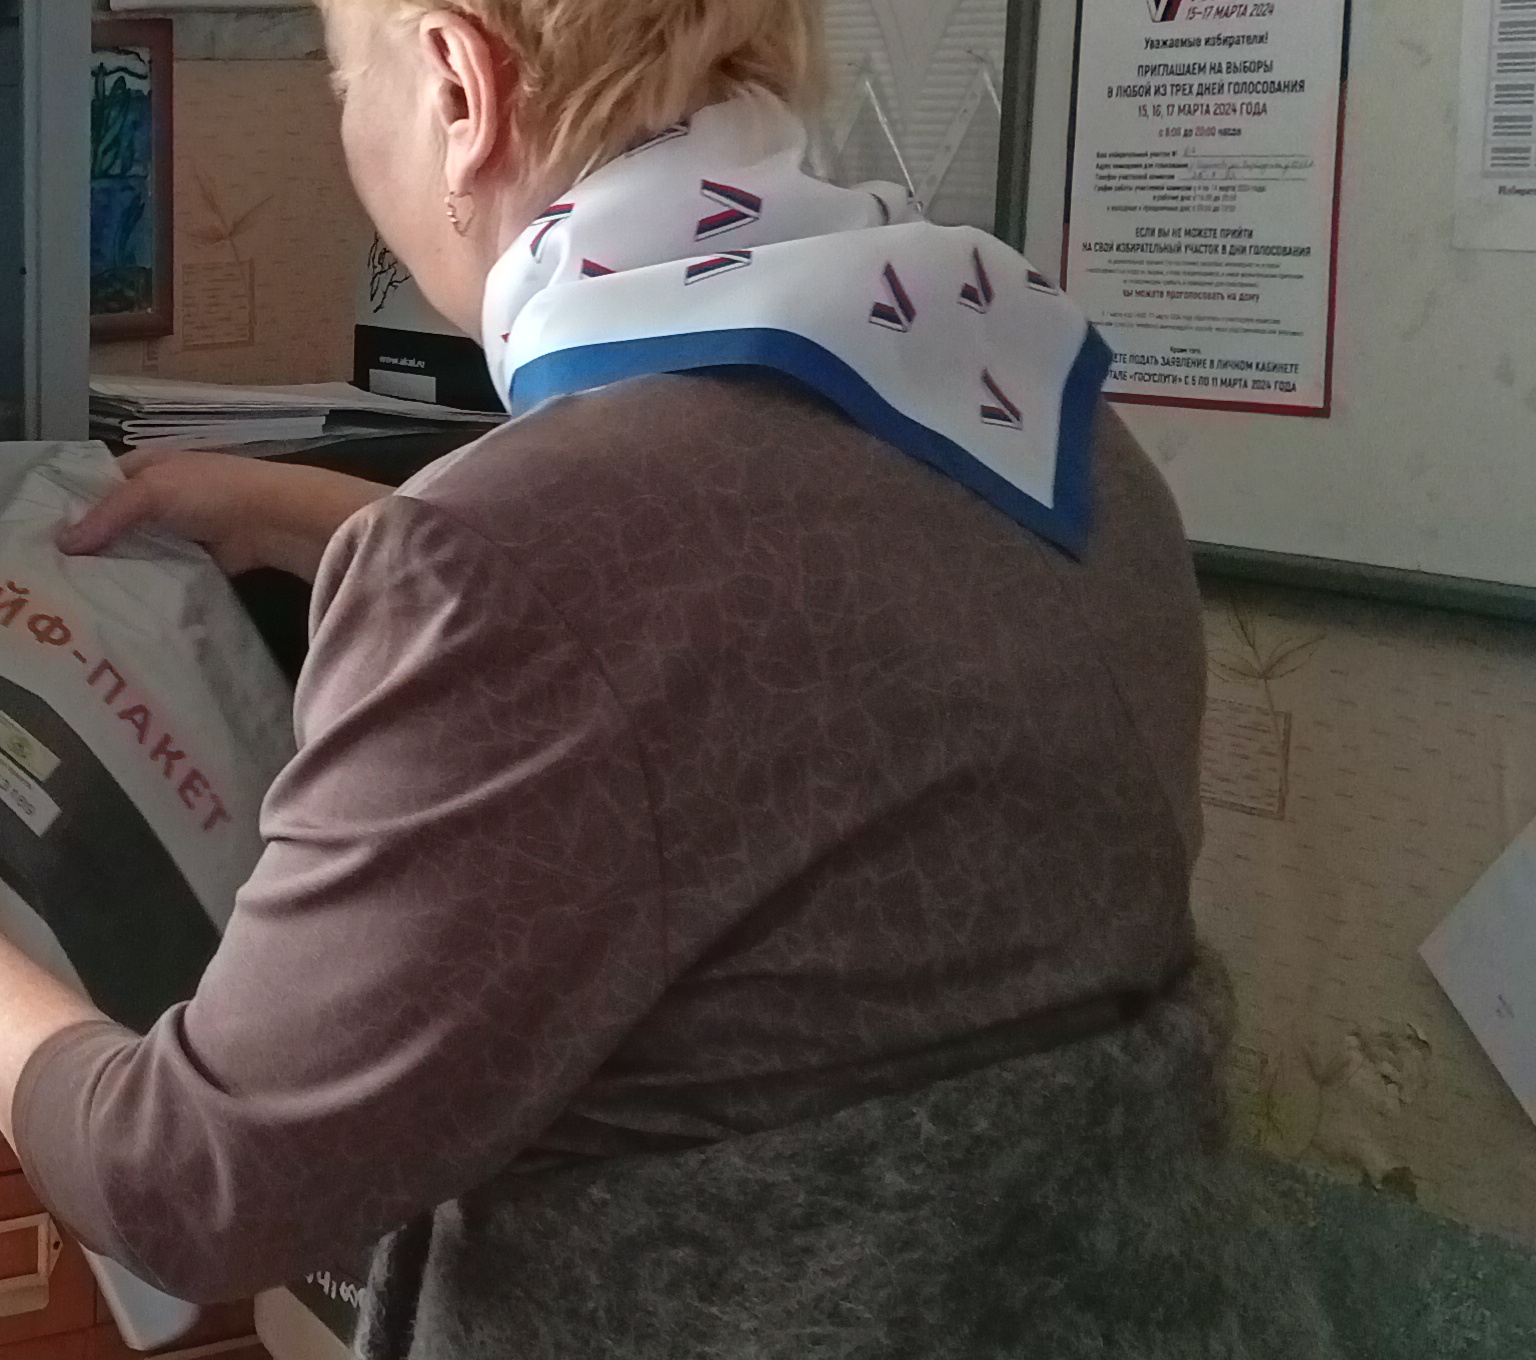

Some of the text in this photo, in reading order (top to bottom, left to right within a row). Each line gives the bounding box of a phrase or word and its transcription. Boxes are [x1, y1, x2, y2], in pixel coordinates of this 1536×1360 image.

[1213, 5, 1248, 20] МАРТА
[1249, 3, 1275, 18] 2024
[1144, 34, 1202, 50] Уважаемые
[1137, 60, 1274, 77] ПРИГЛАШАЕМ НА ВЫБОРЫ
[1107, 79, 1305, 98] В ЛЮБОЙ ИЗ ТРЕХ ДНЕЙ ГОЛОСОВАНИЯ
[1177, 103, 1211, 117] МАРТА
[1212, 102, 1238, 117] 2024
[1239, 101, 1268, 117] ГОДА
[1157, 227, 1170, 239] ВЫ
[1171, 227, 1182, 239] НЕ
[1184, 227, 1217, 240] МОЖЕТЕ
[1184, 242, 1219, 256] УЧАСТОК
[1228, 244, 1246, 257] ДНИ
[1220, 376, 1249, 389] МАРТА
